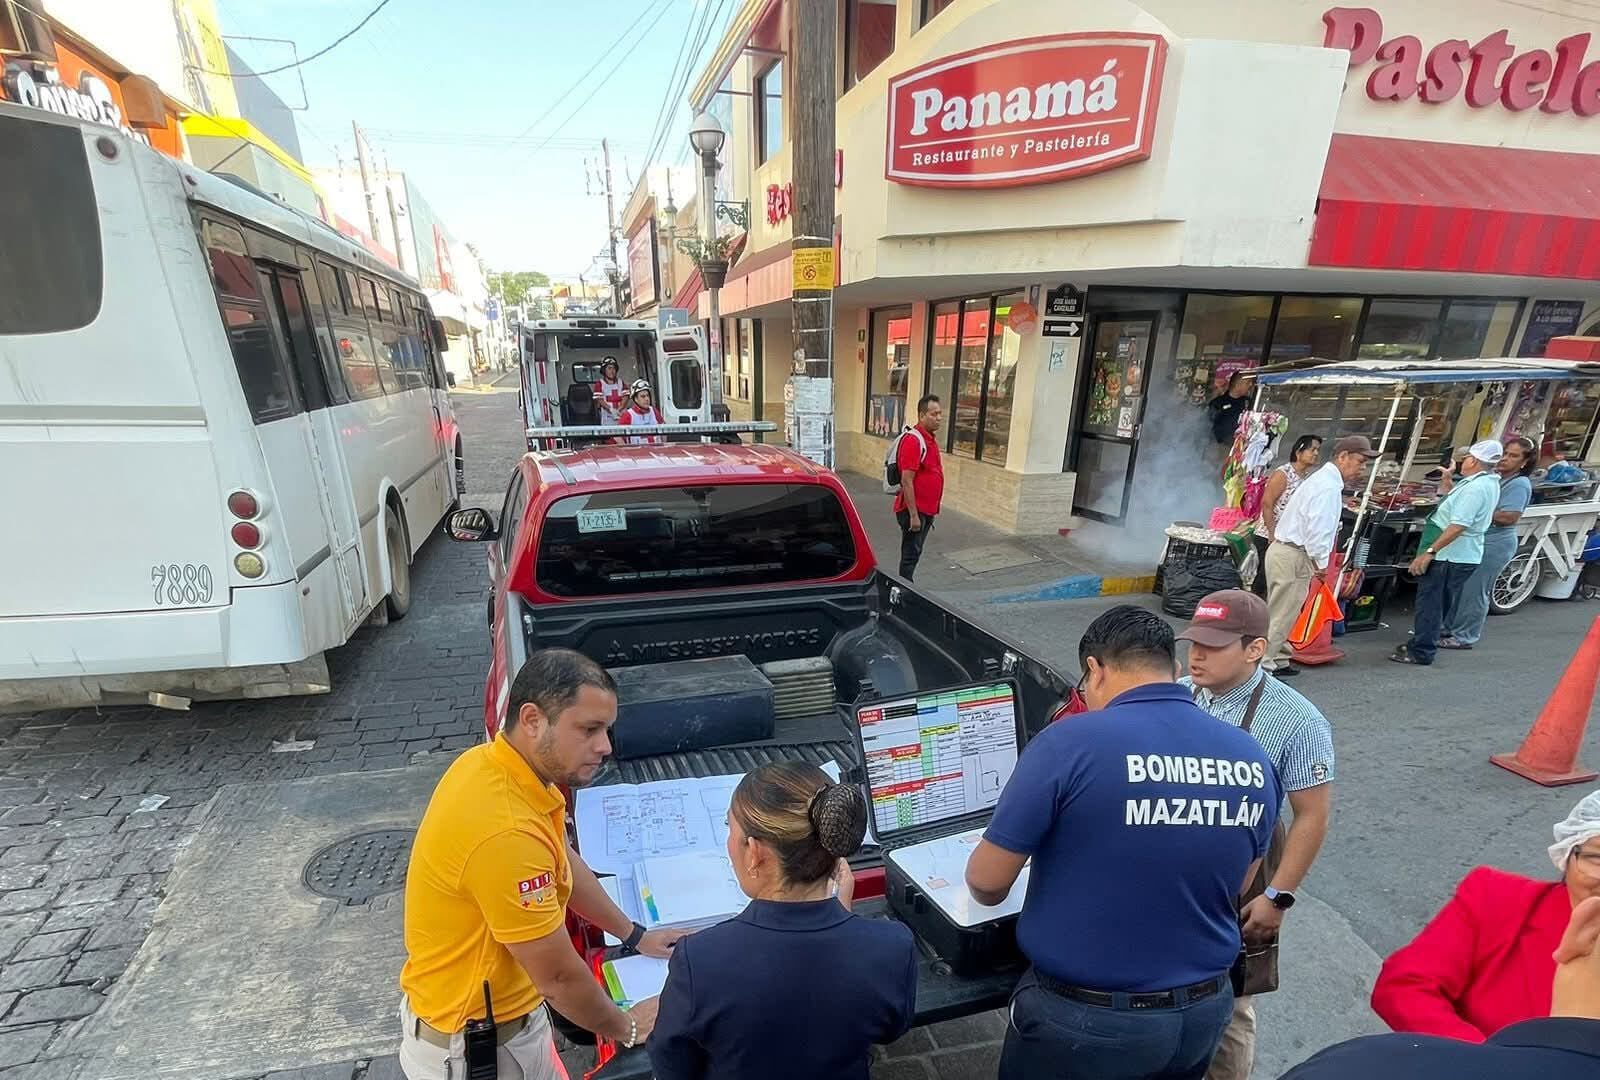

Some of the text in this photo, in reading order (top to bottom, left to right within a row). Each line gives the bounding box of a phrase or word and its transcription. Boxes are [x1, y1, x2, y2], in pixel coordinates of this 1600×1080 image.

[910, 58, 1118, 136] Panamá
[912, 131, 1111, 166] Restaurante y Pastelería
[151, 563, 213, 605] 7889
[745, 628, 820, 649] MOTORS
[1126, 754, 1265, 788] BOMBEROS
[1125, 795, 1265, 827] MAZATLÁN
[520, 873, 549, 892] 911
